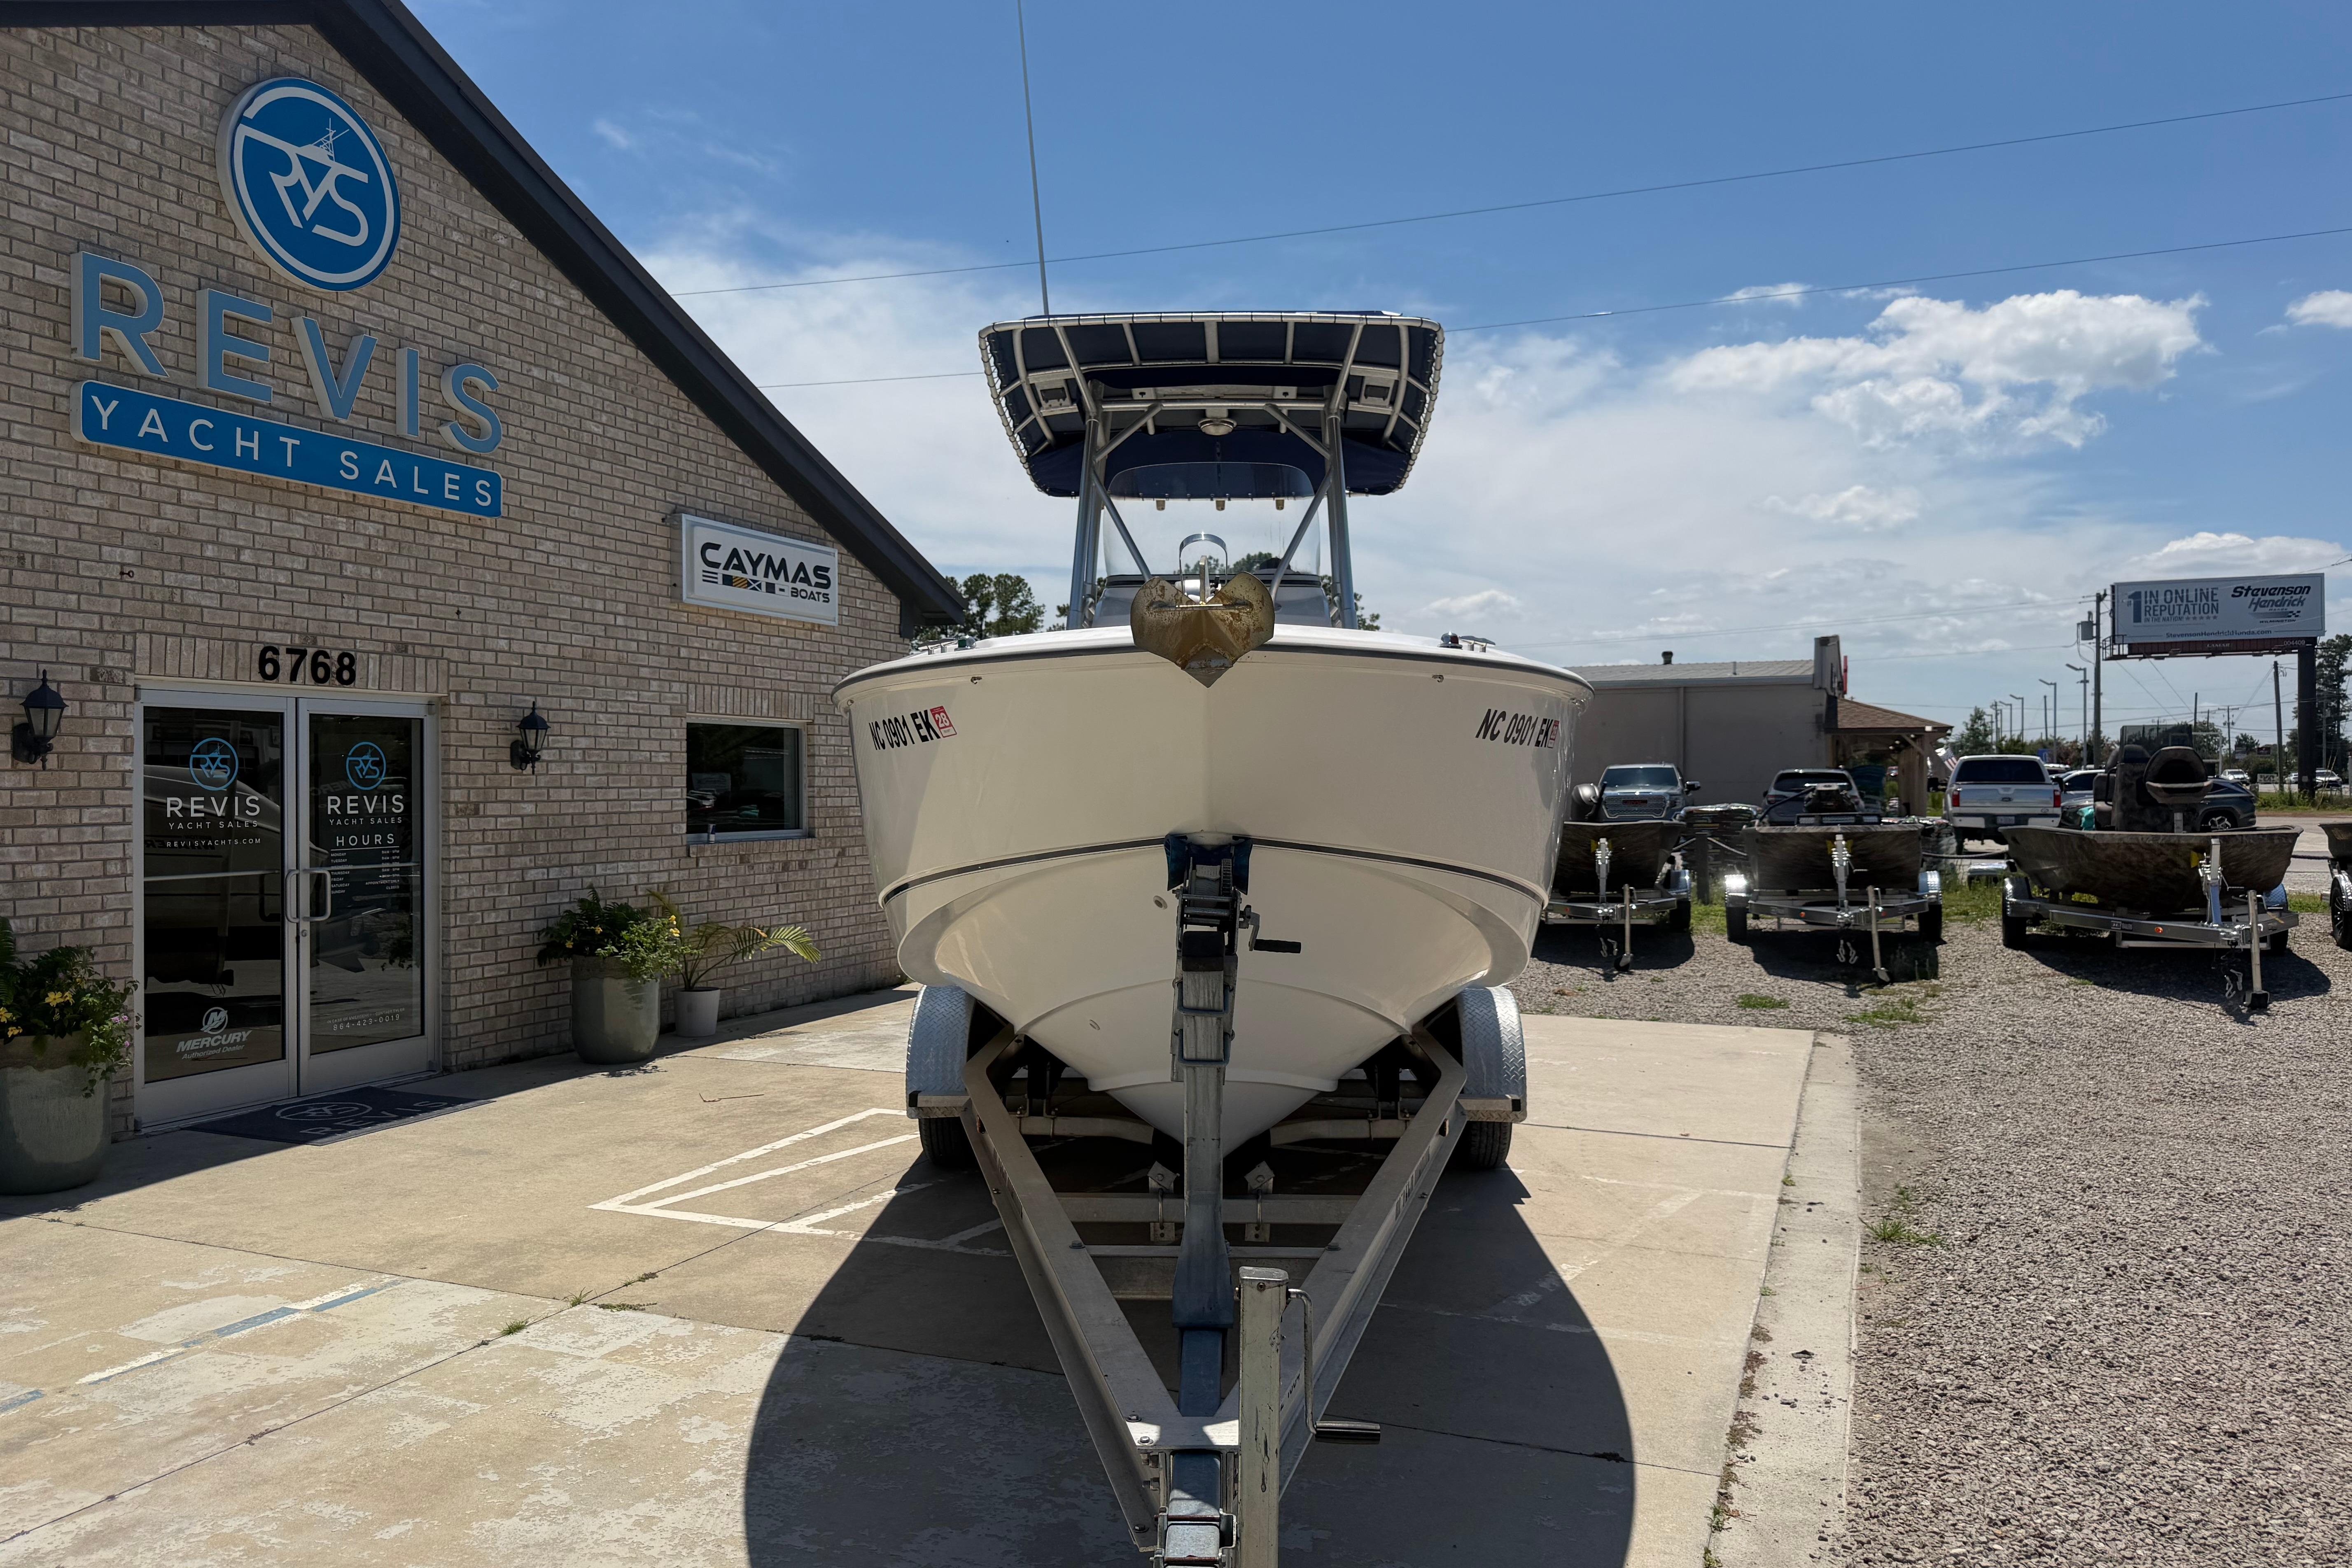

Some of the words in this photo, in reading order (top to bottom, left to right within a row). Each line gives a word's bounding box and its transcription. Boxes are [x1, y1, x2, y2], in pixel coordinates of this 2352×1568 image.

[71, 251, 502, 453] REVIS
[91, 395, 300, 467] YACHT
[340, 451, 492, 506] SALES
[700, 542, 831, 590] CAYMAS
[791, 587, 830, 603] BOATS
[2144, 590, 2158, 604] IN
[2164, 588, 2219, 604] ONLINE
[2231, 586, 2311, 597] Stevenson
[2144, 603, 2219, 616] REPUTATION
[2248, 596, 2306, 612] Hendrick
[258, 646, 356, 686] 6768
[935, 712, 950, 728] 28
[1475, 709, 1506, 741] NC
[1504, 713, 1538, 746] 0901
[1534, 718, 1554, 747] EK
[869, 721, 886, 750] NC
[882, 715, 915, 749] 0901
[910, 709, 941, 742] EK
[167, 796, 260, 817] REVIS
[328, 795, 404, 814] REVIS
[166, 838, 261, 847] REVISYACHTS.COM
[336, 834, 394, 847] HOURS
[333, 1014, 400, 1030] 864-423-0019
[176, 1030, 252, 1052] MERCURY
[182, 1047, 220, 1060] Authorized
[222, 1044, 245, 1053] Dealer
[299, 1101, 448, 1135] REVIS
